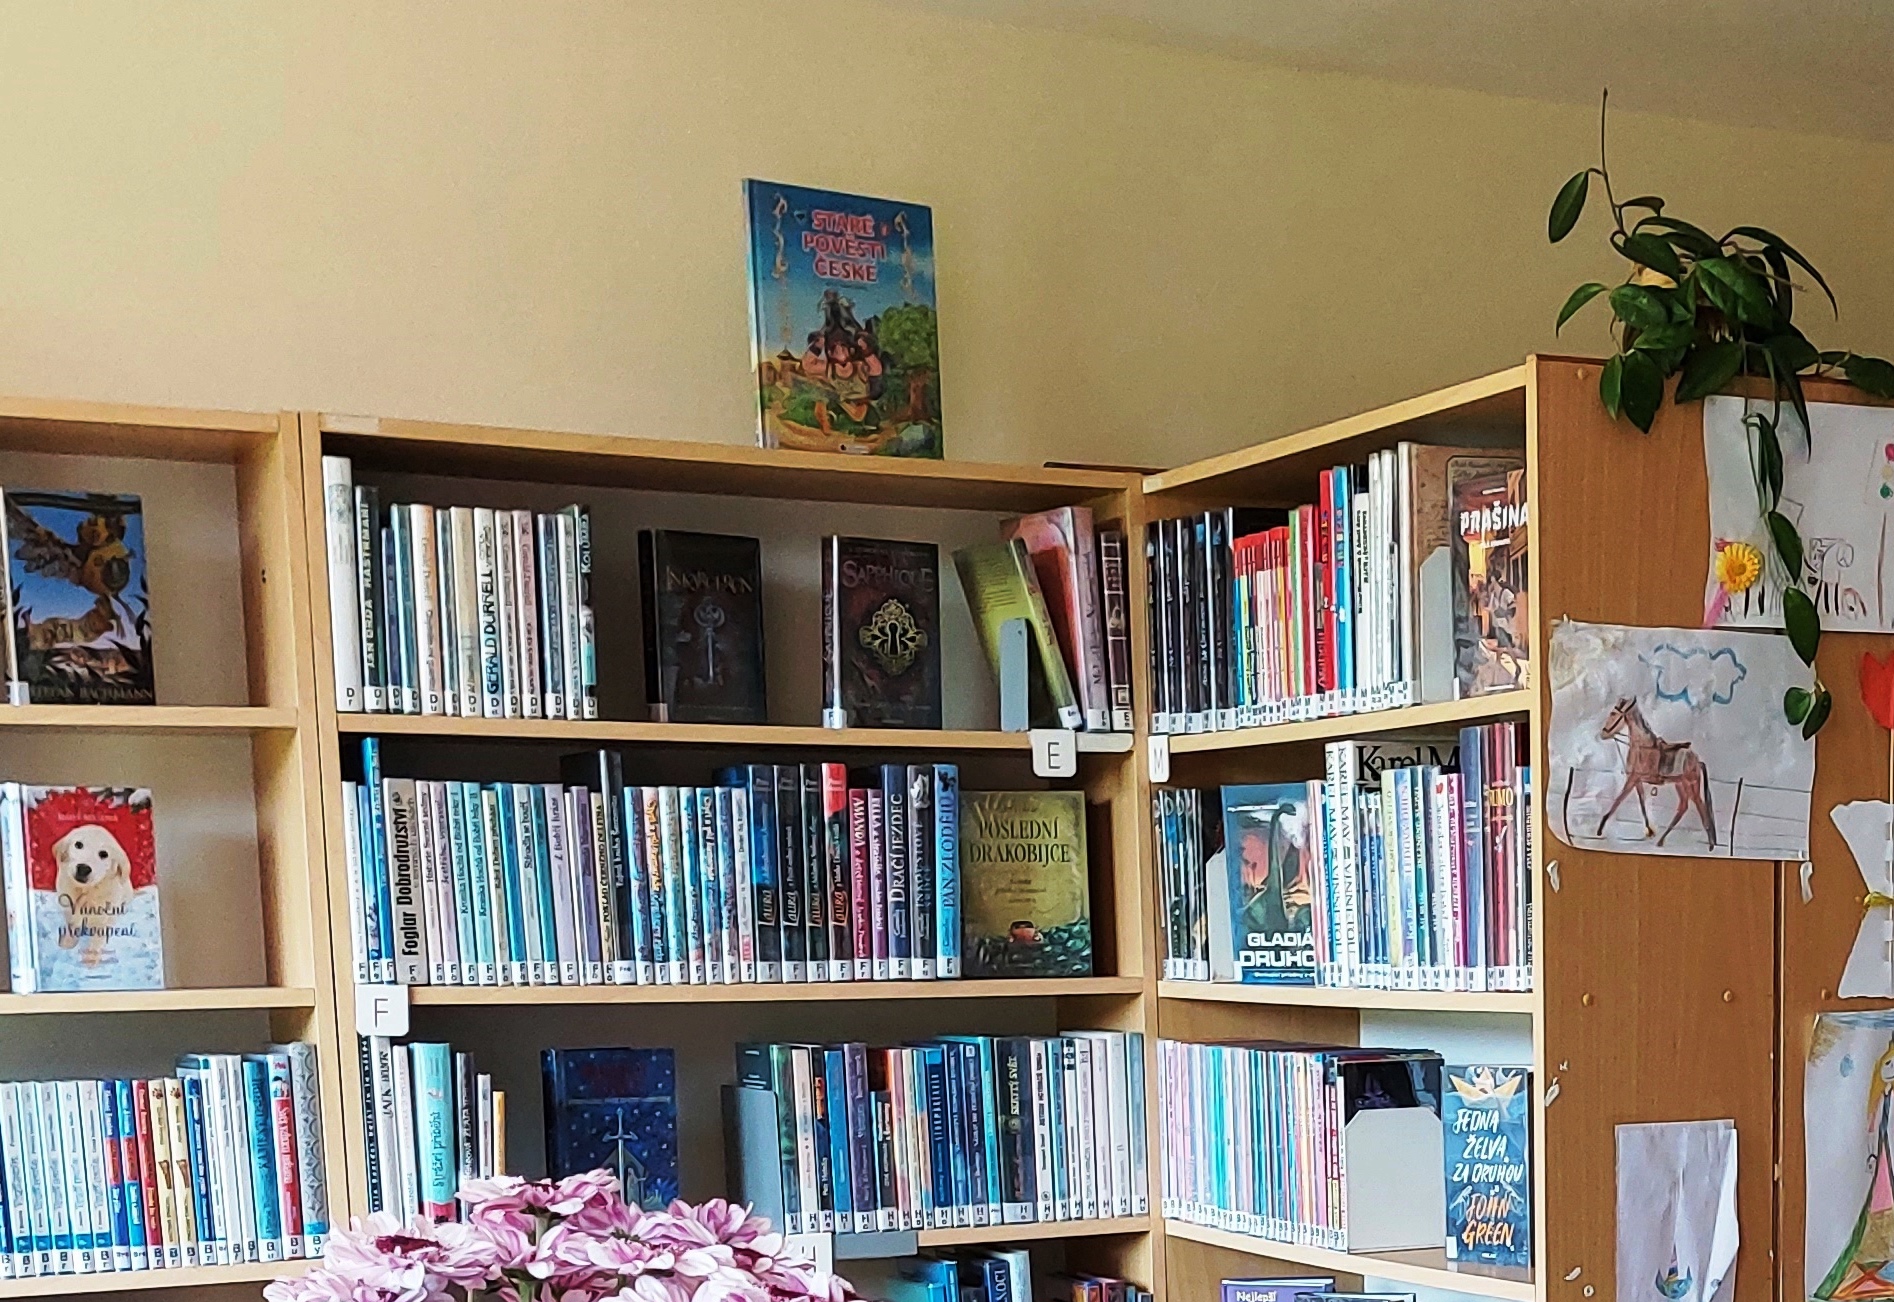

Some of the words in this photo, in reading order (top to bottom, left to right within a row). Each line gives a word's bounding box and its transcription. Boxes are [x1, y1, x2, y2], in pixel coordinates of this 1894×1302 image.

[482, 570, 496, 635] DURRELL
[488, 638, 500, 694] GERALD
[1048, 742, 1061, 769] E
[1153, 746, 1164, 773] M
[890, 794, 905, 851] JEZDEC
[978, 817, 1060, 840] POSLEDNÍ
[969, 843, 1071, 867] DRAKOBIJCE
[890, 852, 906, 902] DRAČÍ
[402, 912, 420, 956] Foglar
[374, 998, 388, 1028] F
[1452, 1109, 1499, 1134] JEDNA
[1452, 1162, 1468, 1184] ZA
[1472, 1161, 1524, 1184] DRUHOU
[1466, 1192, 1508, 1220] JOHN
[1462, 1220, 1514, 1247] GREEN
[1236, 1291, 1276, 1302] Nejlepší
